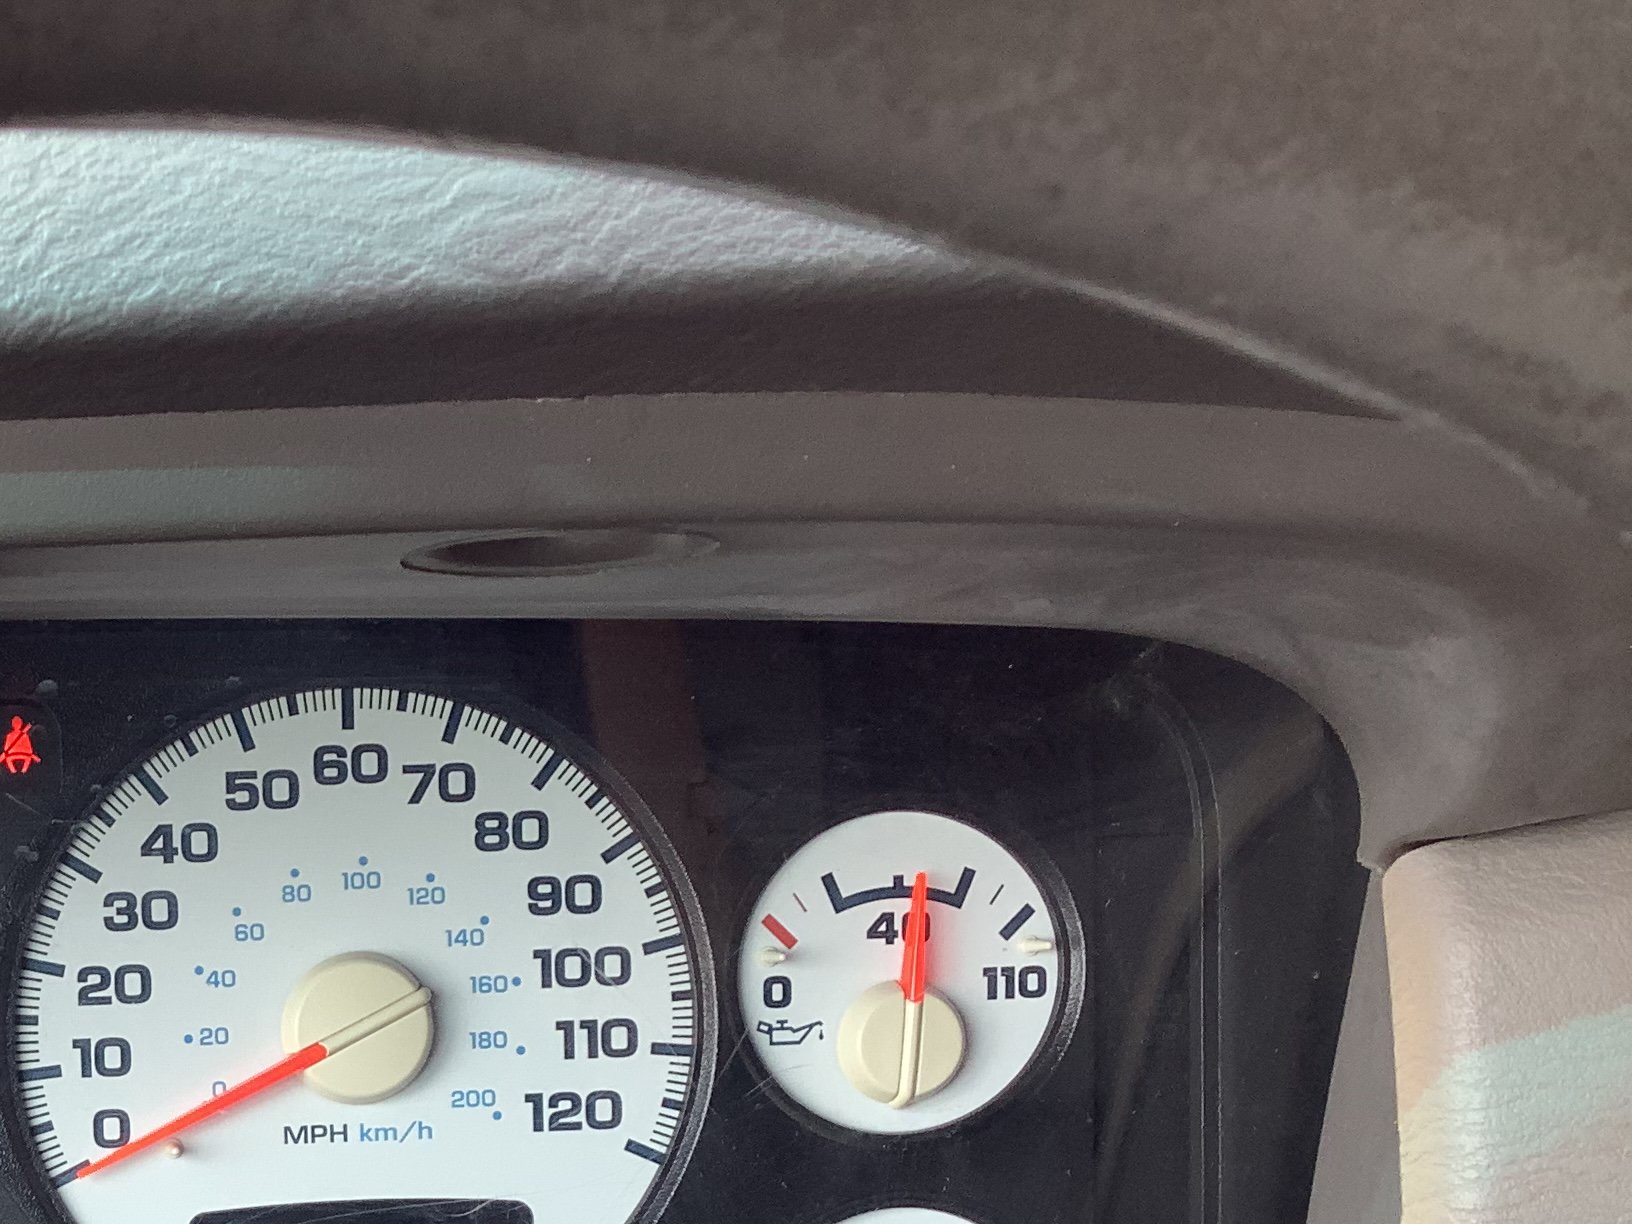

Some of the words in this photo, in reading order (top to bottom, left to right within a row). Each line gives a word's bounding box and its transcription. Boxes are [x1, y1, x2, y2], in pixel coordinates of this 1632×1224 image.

[313, 743, 389, 786] 60
[401, 762, 476, 805] 70
[225, 769, 300, 812] 50
[140, 822, 219, 865] 40
[474, 810, 550, 853] 80
[281, 884, 312, 903] 80
[341, 871, 381, 891] 100
[407, 886, 446, 906] 120
[527, 874, 603, 916] 90
[102, 890, 179, 932] 30
[234, 923, 265, 942] 60
[445, 928, 485, 948] 140
[76, 964, 152, 1007] 20
[205, 969, 236, 988] 40
[469, 975, 508, 994] 160
[532, 946, 632, 989] 100
[982, 965, 1047, 1001] 110
[762, 975, 792, 1009] 0
[199, 1027, 229, 1046] 20
[468, 1030, 508, 1050] 180
[555, 1018, 639, 1060] 110
[71, 1037, 132, 1079] 10
[451, 1088, 496, 1108] 200
[524, 1090, 623, 1133] 120
[92, 1108, 131, 1149] 0
[283, 1123, 348, 1145] MPH
[359, 1120, 433, 1143] km/h
